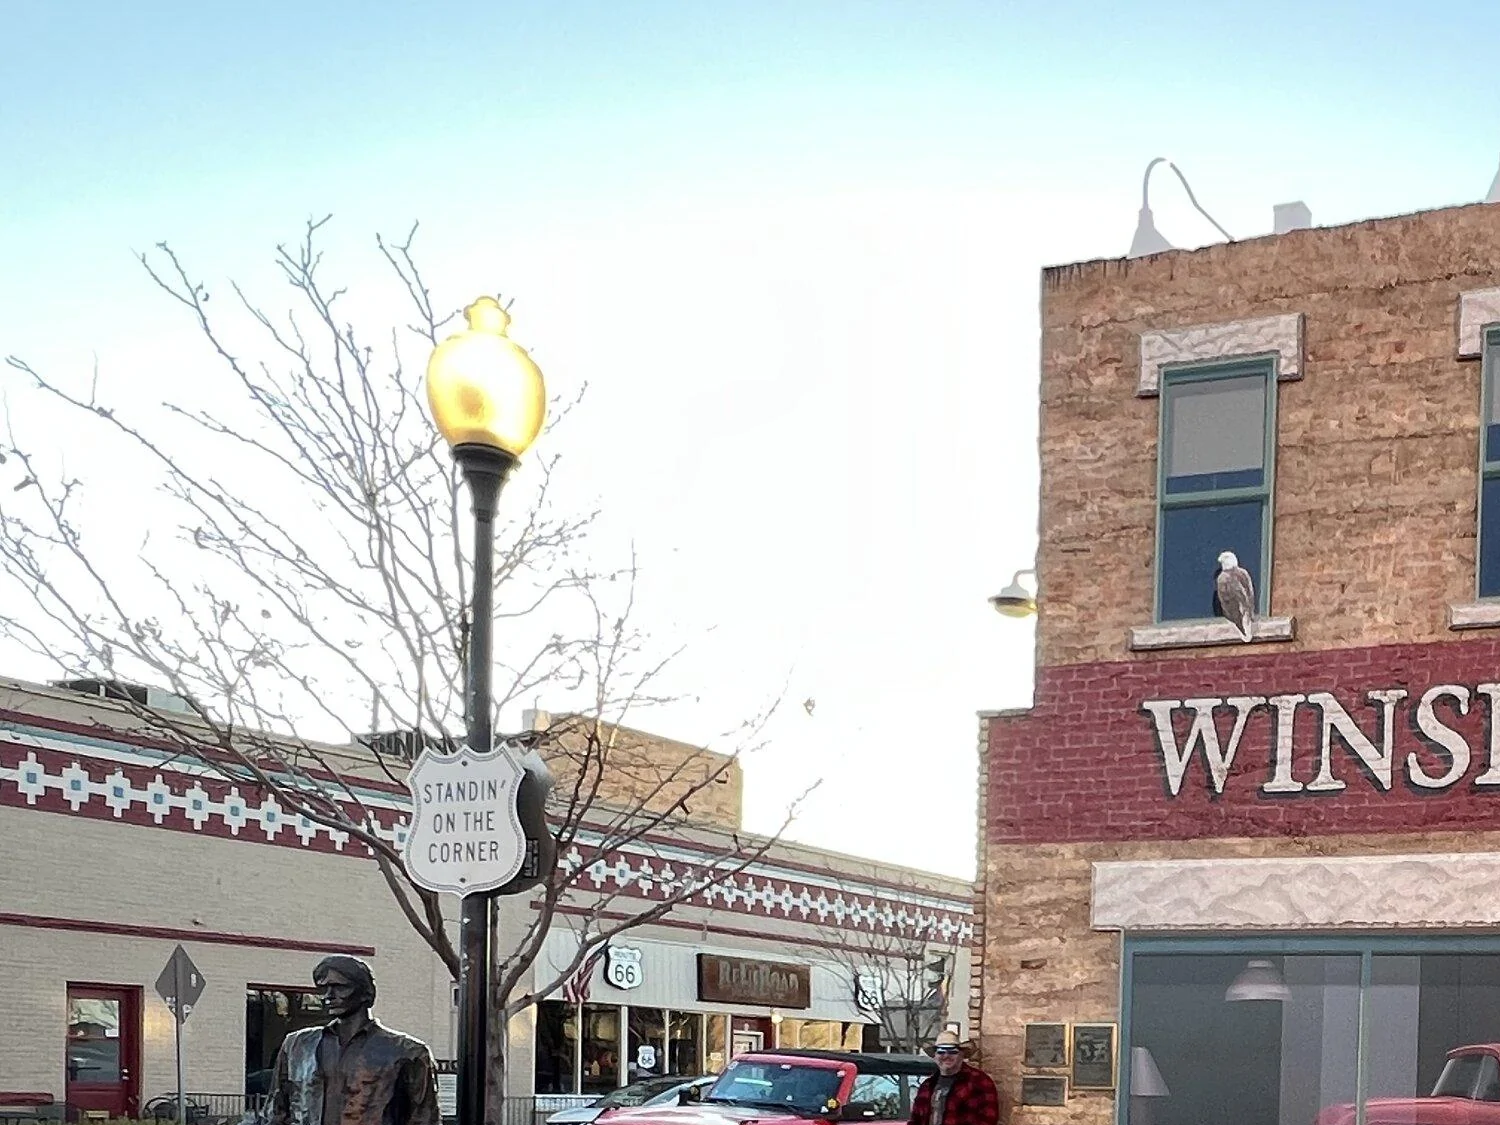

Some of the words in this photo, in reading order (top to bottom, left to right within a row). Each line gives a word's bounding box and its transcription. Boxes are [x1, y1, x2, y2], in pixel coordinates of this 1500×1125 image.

[424, 779, 506, 804] STANDIN'
[433, 812, 456, 834] ON
[464, 811, 496, 832] THE
[428, 841, 499, 864] CORNER
[615, 964, 635, 984] 66
